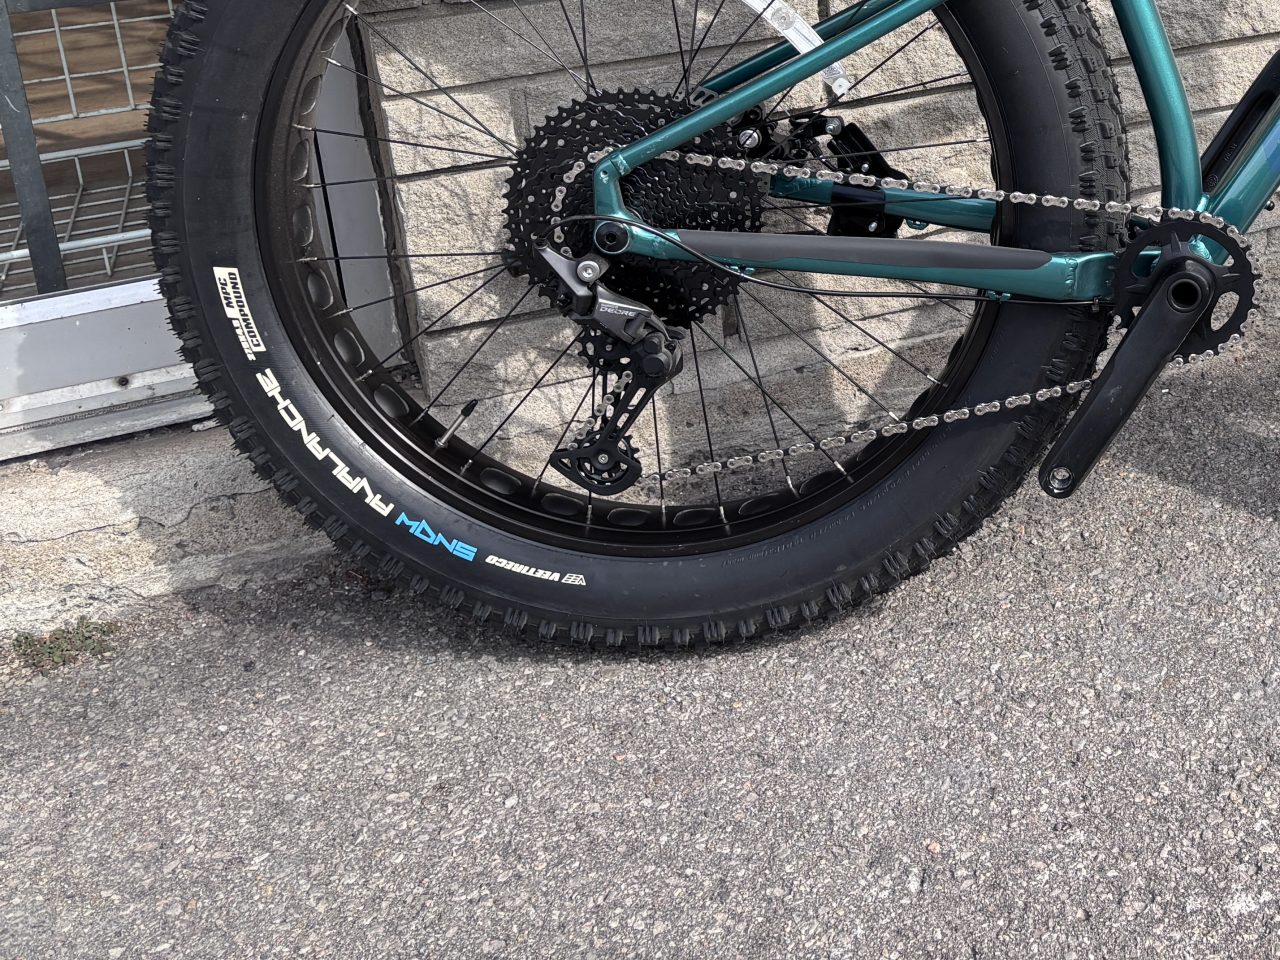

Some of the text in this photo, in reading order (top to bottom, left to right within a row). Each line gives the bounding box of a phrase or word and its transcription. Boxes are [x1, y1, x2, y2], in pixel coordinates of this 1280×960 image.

[216, 276, 234, 310] MPC
[226, 271, 263, 348] COMPOUND
[600, 306, 637, 317] DEORE
[255, 368, 395, 517] AVALANCHE
[395, 512, 478, 562] SNOW
